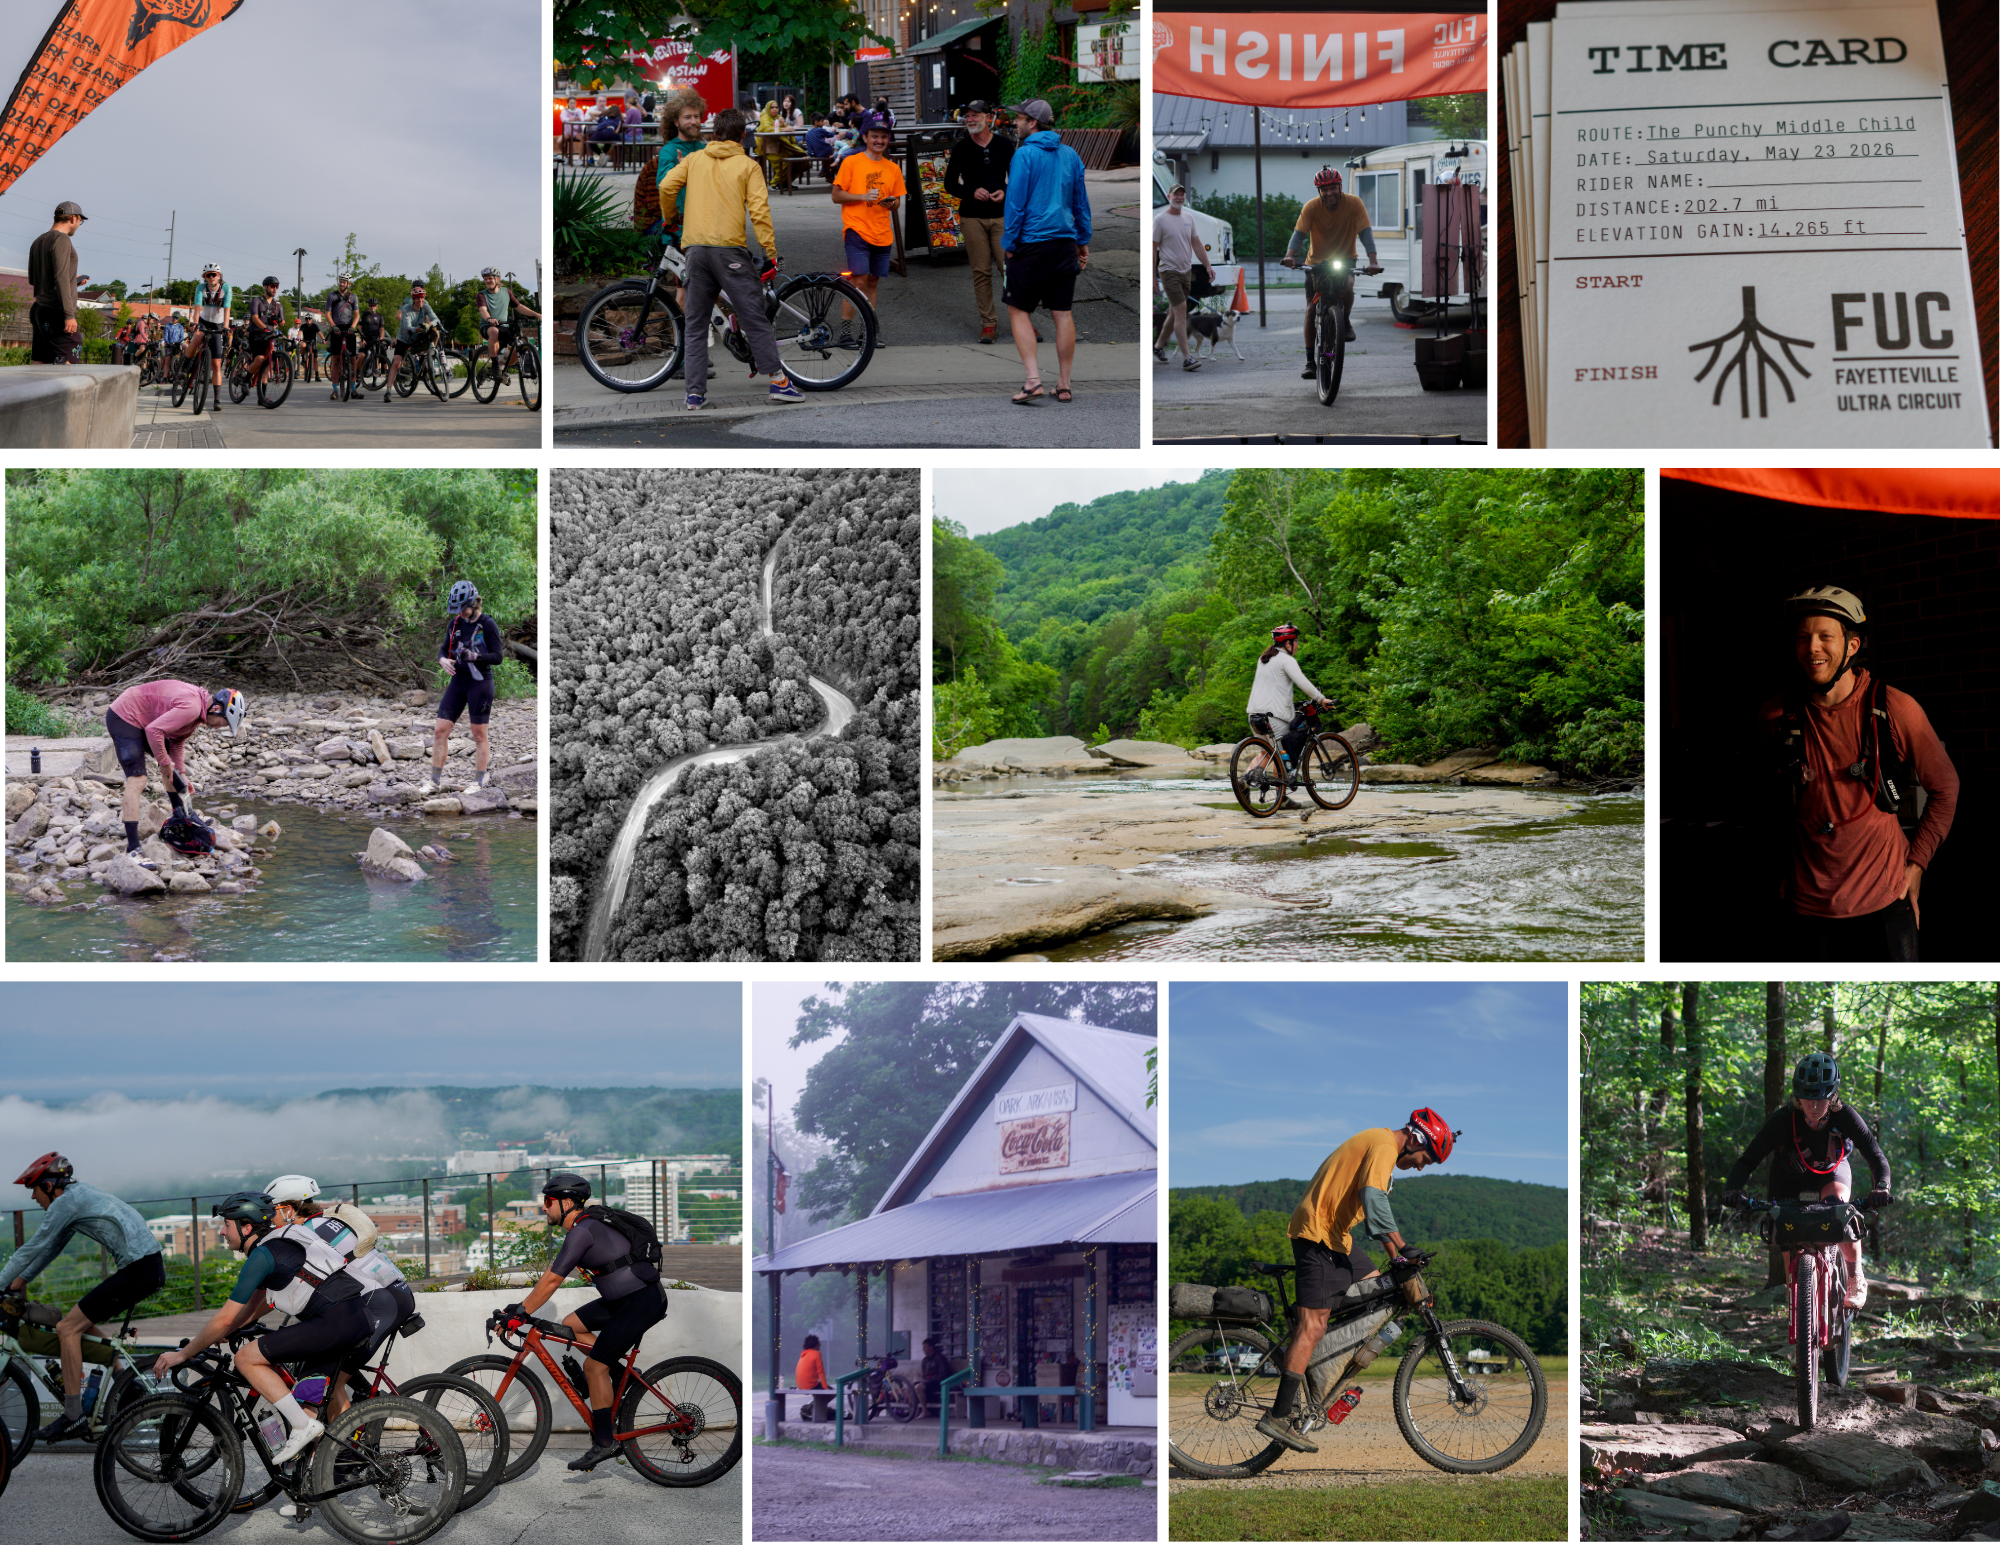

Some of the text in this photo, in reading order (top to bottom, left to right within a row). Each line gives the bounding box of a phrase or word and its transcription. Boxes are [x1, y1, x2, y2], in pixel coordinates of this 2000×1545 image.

[1588, 37, 1908, 74] TIME CARD
[31, 63, 82, 93] OZARK
[72, 56, 124, 88] OZARK
[667, 64, 708, 77] ASIAN
[7, 107, 58, 135] OZARK
[1694, 120, 1763, 138] Punchy
[1776, 118, 1845, 134] Middle
[1859, 116, 1916, 132] Child
[1576, 142, 1895, 168] DATE: Saturday, May 23 2026
[1576, 173, 1704, 192] RIDER NAME:
[1756, 195, 1779, 210] mi
[1576, 225, 1683, 243] ELEVATION
[1844, 219, 1866, 234] ft
[1576, 274, 1643, 289] START
[1831, 291, 1954, 351] FUC
[1574, 365, 1658, 382] FINISH
[1835, 366, 1959, 385] FAYETTEVILLE
[1837, 392, 1962, 412] ULTRA CIRCUIT
[1886, 779, 1900, 800] USWE
[561, 1383, 582, 1407] CRUZ
